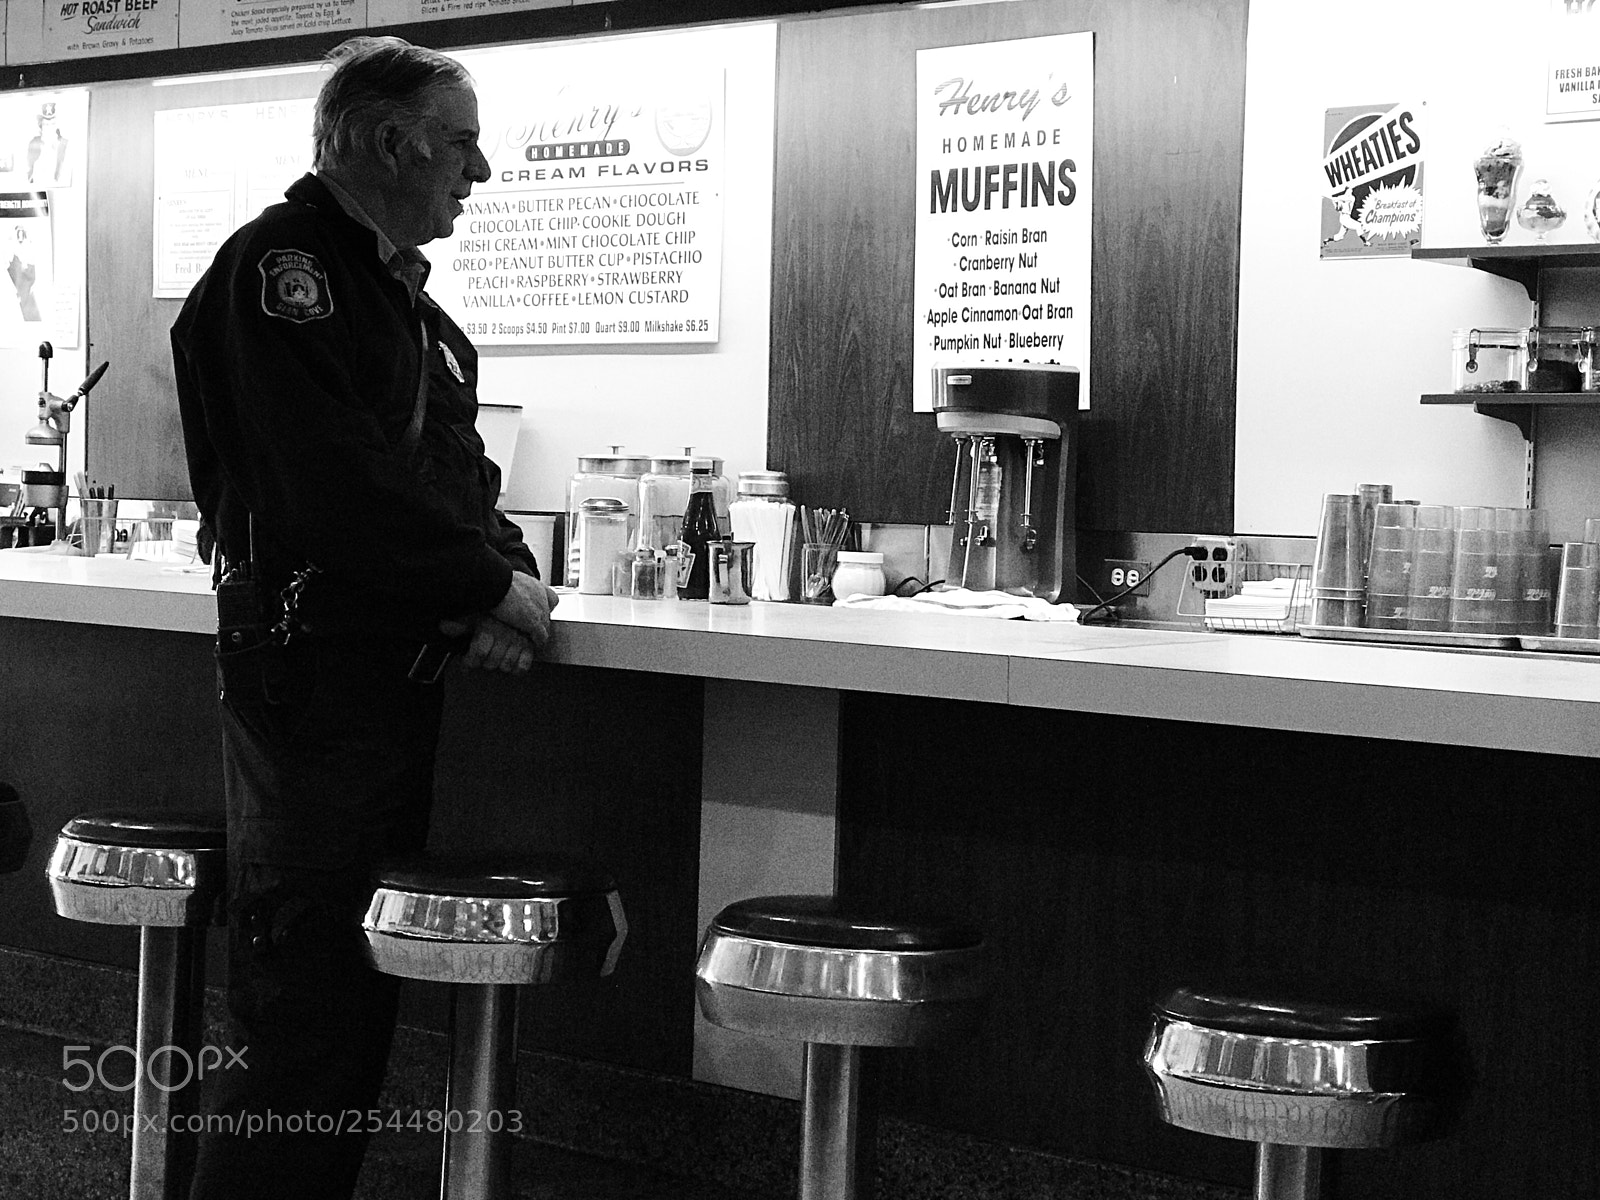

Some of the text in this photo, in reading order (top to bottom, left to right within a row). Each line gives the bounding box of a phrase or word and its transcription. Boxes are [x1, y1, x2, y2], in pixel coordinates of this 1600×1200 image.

[60, 0, 158, 16] HOT ROAST BEEF
[463, 2, 474, 10] red
[82, 12, 141, 35] Sandwich
[102, 40, 119, 50] Gravy
[1555, 68, 1582, 80] FRESH
[934, 72, 1071, 121] Henry's
[1559, 80, 1595, 93] VANILLA
[530, 142, 625, 160] HOMEMADE
[943, 129, 1060, 154] HOMEMADE
[1324, 111, 1420, 188] WHEATIES
[502, 159, 708, 182] CREAM FLAVORS
[930, 159, 1076, 214] MUFFINS
[459, 192, 699, 216] ANANA BUTTER PECAN CHOCOLATE
[1375, 199, 1417, 210] Breakfast of
[470, 212, 685, 234] CHOCOLATE CHIP COOKIE DOUGH
[1365, 209, 1416, 227] Champions
[460, 231, 695, 252] IRISH CREAM MINT CHOCOLATE CHIP
[952, 228, 1047, 247] Corn Raisin Bran
[269, 261, 324, 280] ENFORCEMENT
[453, 250, 702, 271] OREO PEANUT BUTTER CUP PISTACHIO
[959, 252, 1037, 273] Cranberry Nut
[469, 271, 683, 289] PEACH RASPBERRY STRAWBERRY
[939, 277, 1060, 298] Oat Bran Banana Nut
[463, 290, 688, 308] VANILLA COFFEE LEMON CUSTARD
[927, 304, 1073, 327] Apple Cinnamon Oat Bran
[466, 323, 487, 335] $3.50
[492, 323, 496, 334] 2
[499, 323, 523, 336] Scoops
[526, 323, 547, 334] $4.50
[552, 323, 566, 333] Pint
[569, 322, 589, 333] $7.00
[596, 322, 615, 333] Quart
[618, 321, 639, 333] $9.00
[645, 320, 683, 332] Milkshake
[686, 320, 708, 332] $6.25
[934, 332, 1064, 354] Pumpkin Nut Blueberry
